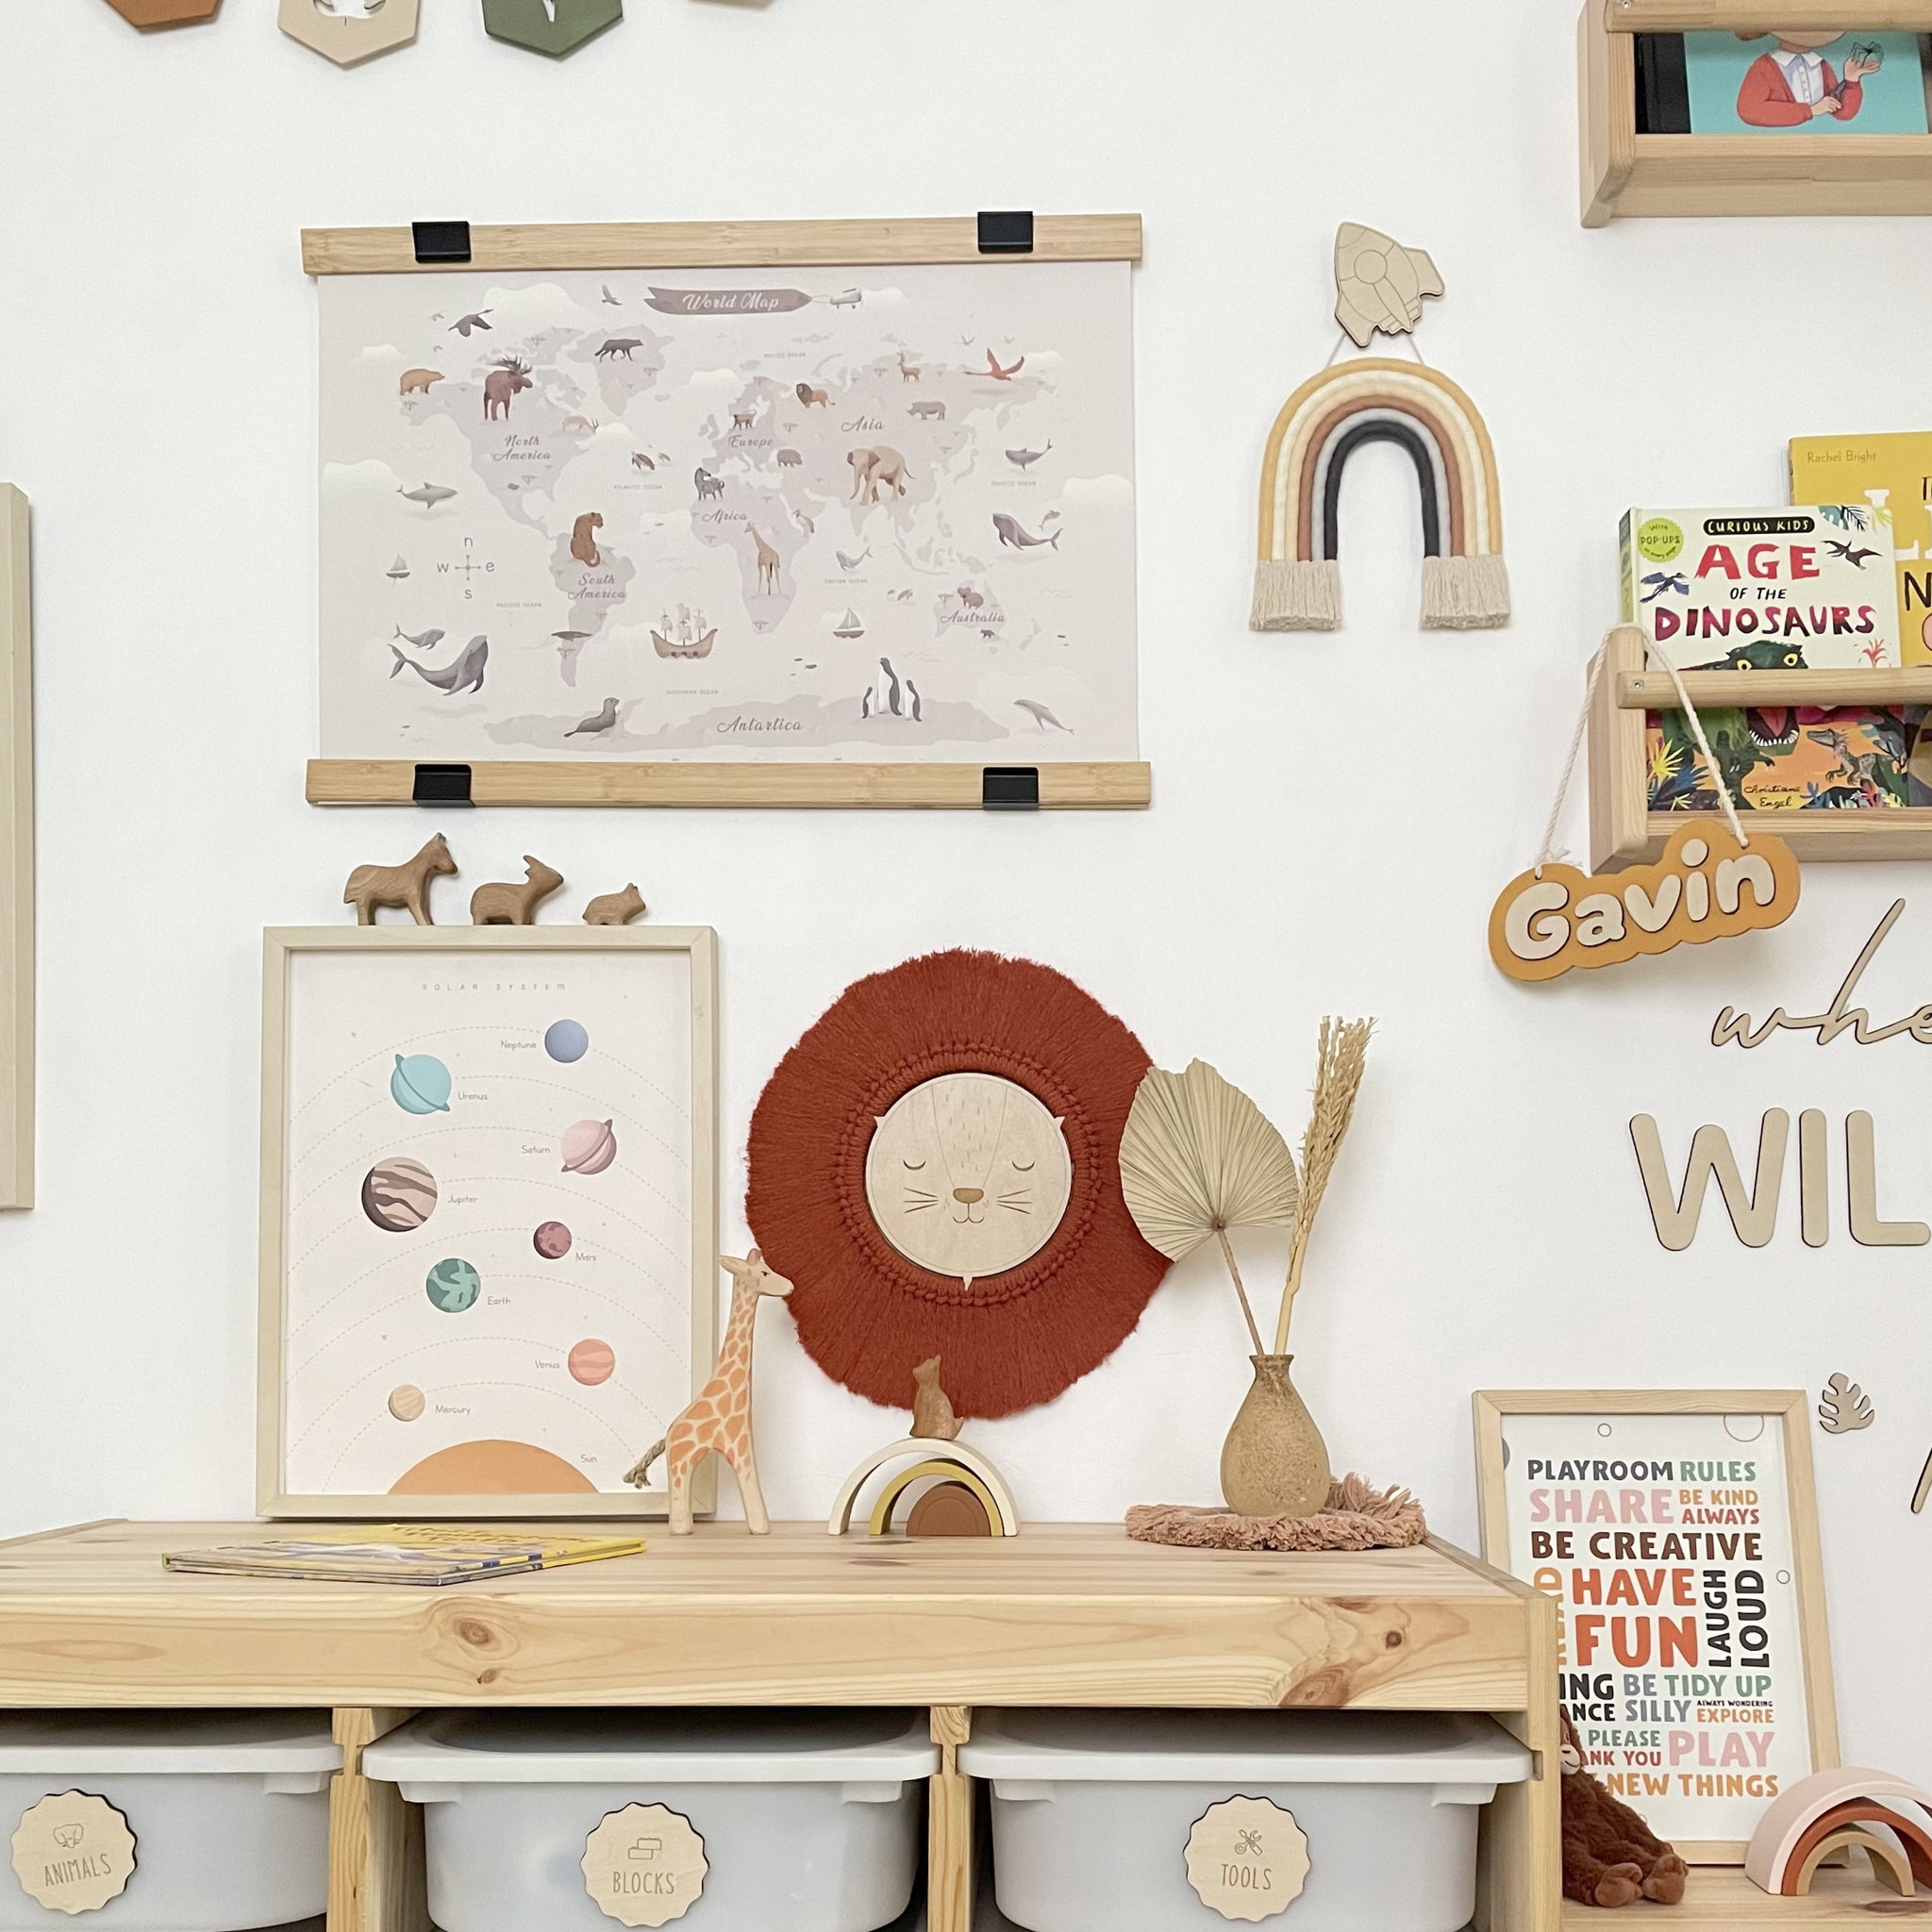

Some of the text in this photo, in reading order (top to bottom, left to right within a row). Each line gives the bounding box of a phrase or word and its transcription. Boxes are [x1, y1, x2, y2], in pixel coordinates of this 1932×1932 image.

[682, 292, 779, 311] World Map
[841, 415, 883, 432] Asia
[504, 434, 540, 447] North
[728, 435, 774, 449] Europe
[492, 448, 551, 461] America
[1807, 449, 1876, 463] Rachel Bright
[702, 508, 747, 525] Africa
[1707, 519, 1809, 534] CURIOUS KIDS
[1641, 535, 1680, 545] POP-UPS
[1695, 543, 1820, 580] AGE
[578, 573, 616, 585] South
[568, 587, 626, 600] America
[1730, 588, 1788, 600] OF THE
[940, 610, 1005, 624] Australia
[1655, 606, 1876, 641] DINOSAURS
[717, 715, 804, 733] Antartica
[1505, 838, 1775, 960] Gavin
[1711, 898, 1932, 1048] whe
[423, 983, 479, 991] SOLAR
[500, 1040, 537, 1051] Neptune
[458, 1091, 488, 1102] Uranus
[521, 1144, 551, 1155] Saturn
[1629, 1108, 1931, 1251] WIL
[447, 1193, 478, 1206] Jupiter
[575, 1253, 597, 1262] Mars
[488, 1295, 511, 1306] Earth
[535, 1359, 560, 1370] Venus
[435, 1405, 471, 1417] Mercury
[580, 1454, 598, 1463] Sun
[1527, 1459, 1757, 1482] PLAYROOM RULES
[1529, 1489, 1674, 1524] SHARE
[1679, 1490, 1758, 1506] BE KIND
[1681, 1508, 1759, 1524] ALWAYS
[1531, 1531, 1763, 1561] BE CREATIVE
[1572, 1568, 1697, 1607] HAVE
[1703, 1570, 1732, 1667] LAUGH
[1735, 1570, 1770, 1668] LOUD
[1574, 1614, 1698, 1668] FUN
[1559, 1674, 1614, 1700] ING
[1624, 1674, 1657, 1696] BE
[1664, 1674, 1773, 1697] TIDY UP
[1560, 1703, 1616, 1722] NCE
[1625, 1699, 1691, 1722] SILLY
[1697, 1708, 1774, 1724] EXPLORE
[1589, 1729, 1661, 1747] PLEASE
[1669, 1730, 1775, 1768] PLAY
[1580, 1751, 1661, 1767] ANK YOU
[1607, 1774, 1779, 1797] NEW THINGS
[44, 1853, 112, 1886] ANIMALS
[1222, 1864, 1272, 1890] TOOLS
[613, 1871, 675, 1894] BLOCKS
